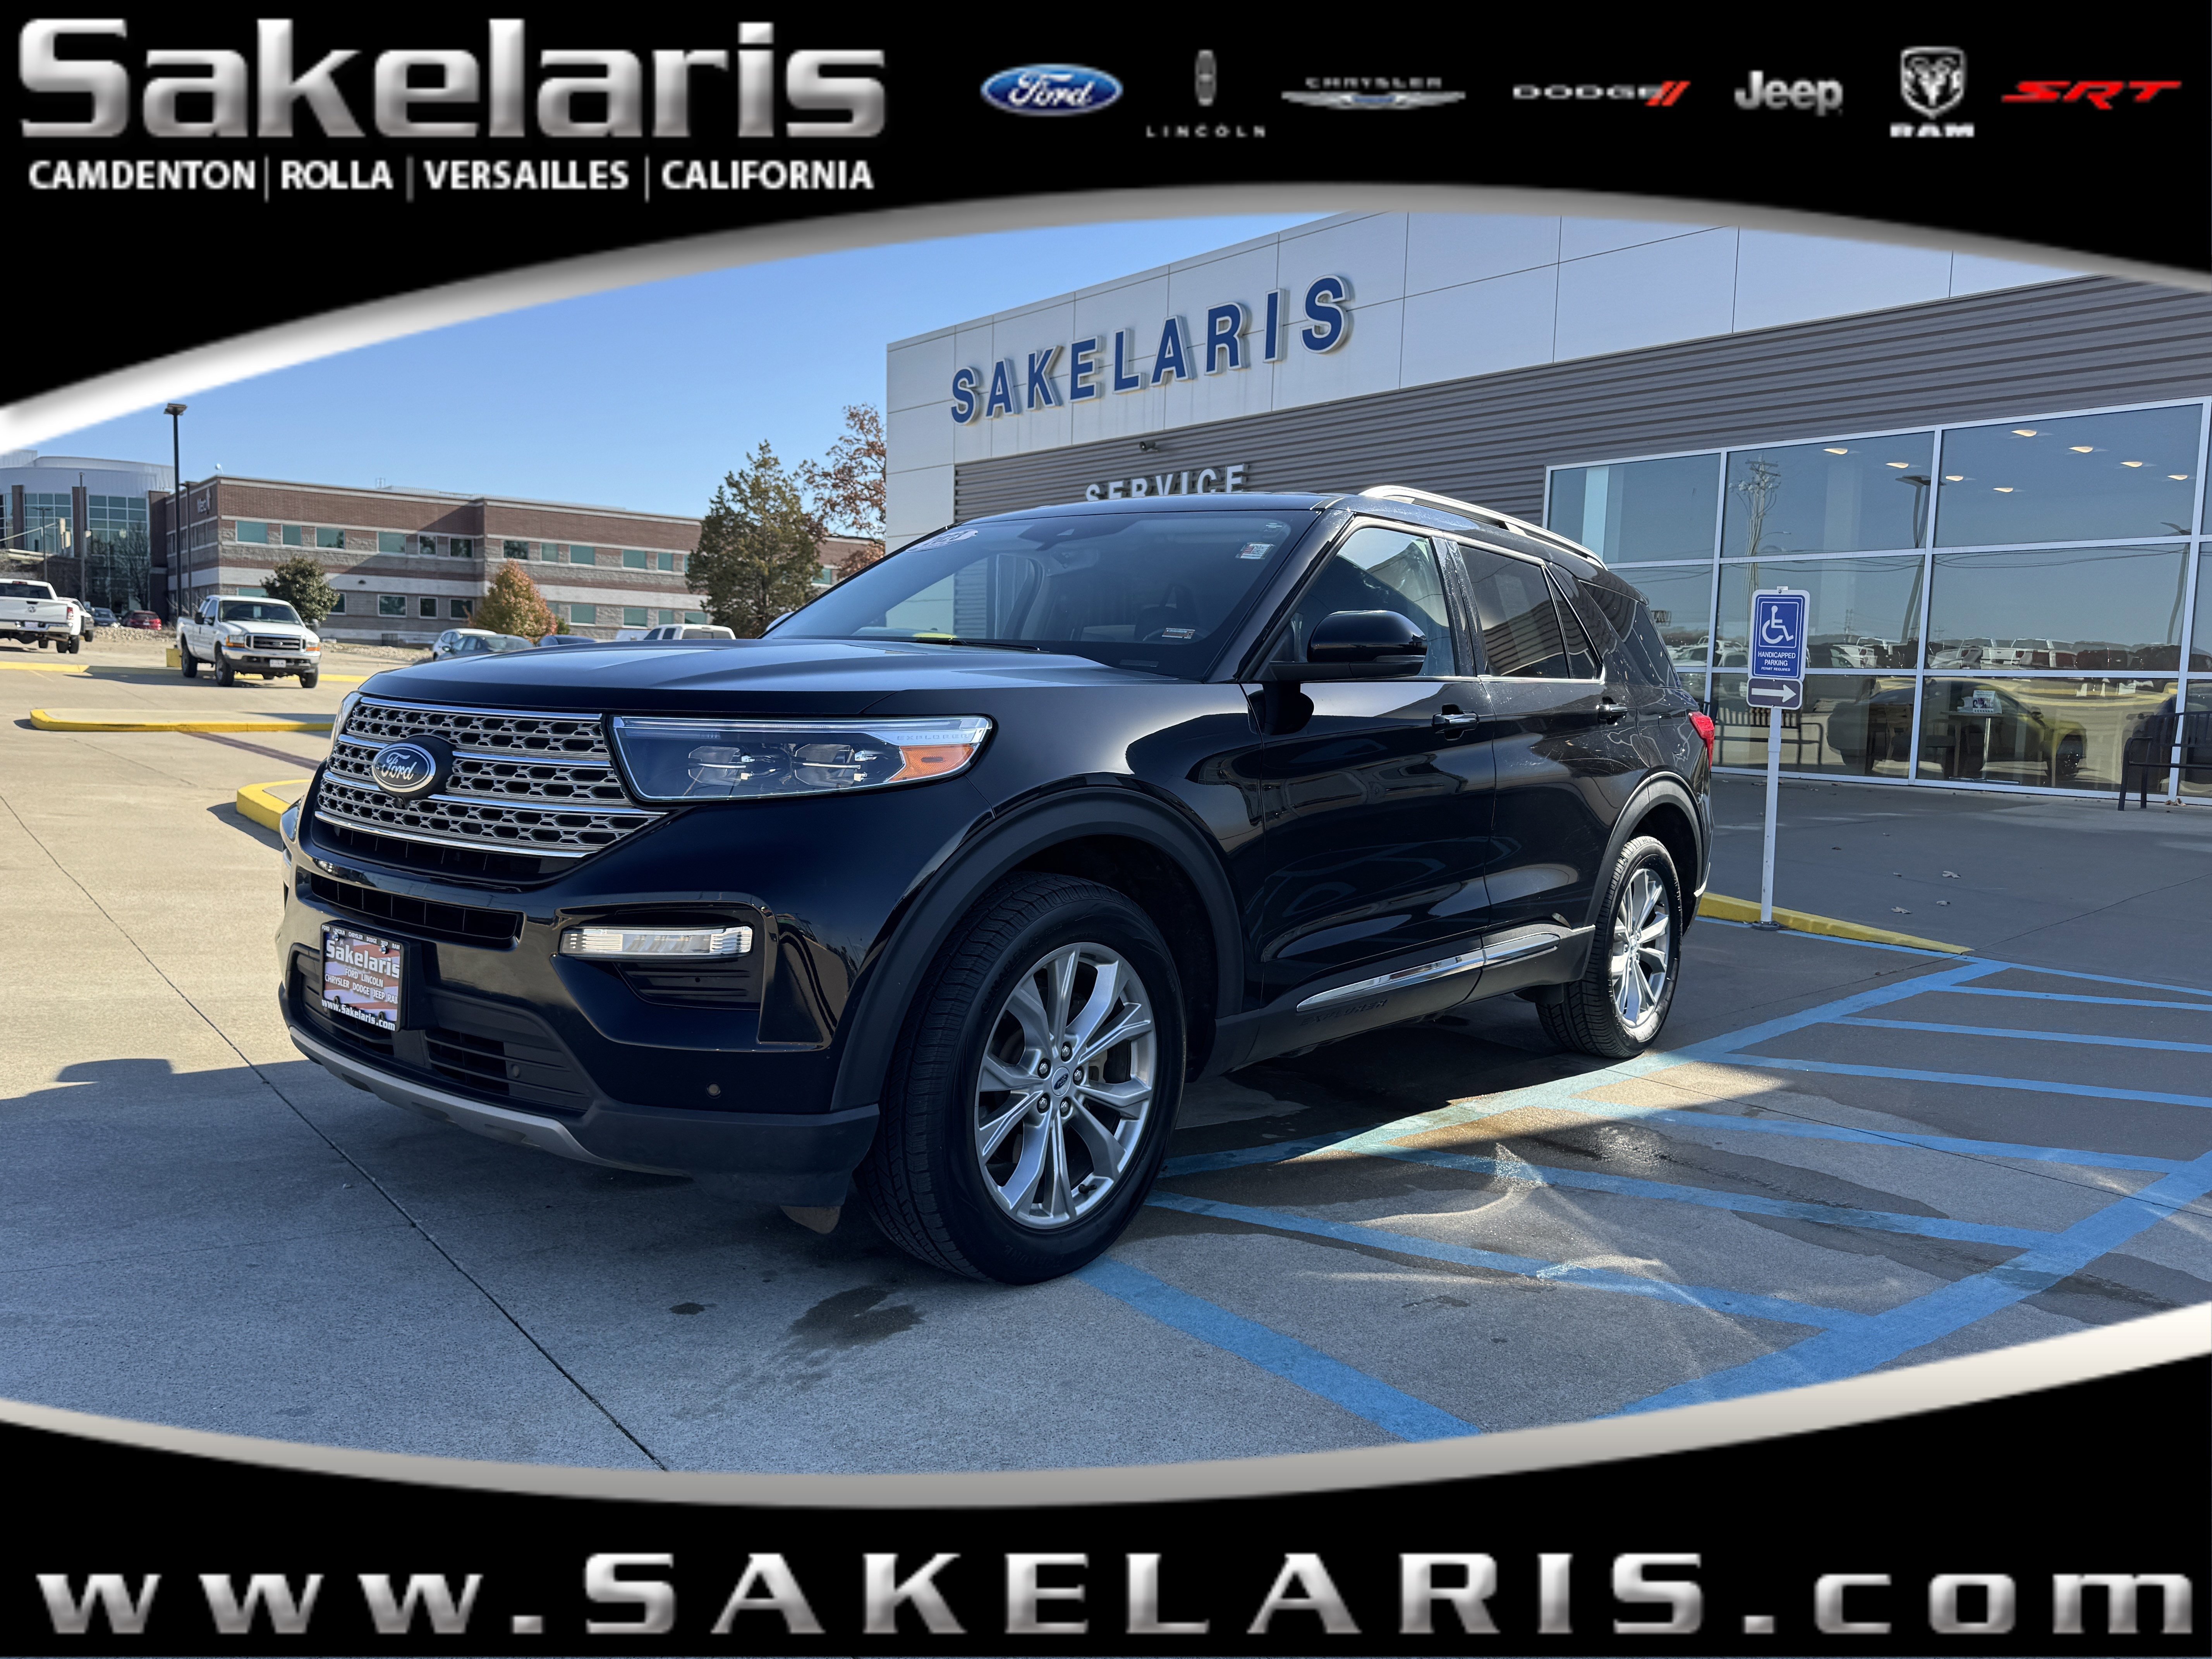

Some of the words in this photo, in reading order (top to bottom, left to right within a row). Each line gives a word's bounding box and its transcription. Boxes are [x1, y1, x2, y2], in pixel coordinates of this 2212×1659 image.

[950, 274, 1352, 425] SAKELARIS
[381, 752, 417, 780] Ford
[326, 939, 400, 979] Sakelaris
[325, 974, 350, 989] CHRYSLER
[353, 982, 370, 995] DODGE
[373, 989, 385, 1000] JEEP
[345, 968, 358, 979] FORD
[361, 973, 383, 988] LINCOLN
[321, 999, 395, 1031] www.Sakelaris.com
